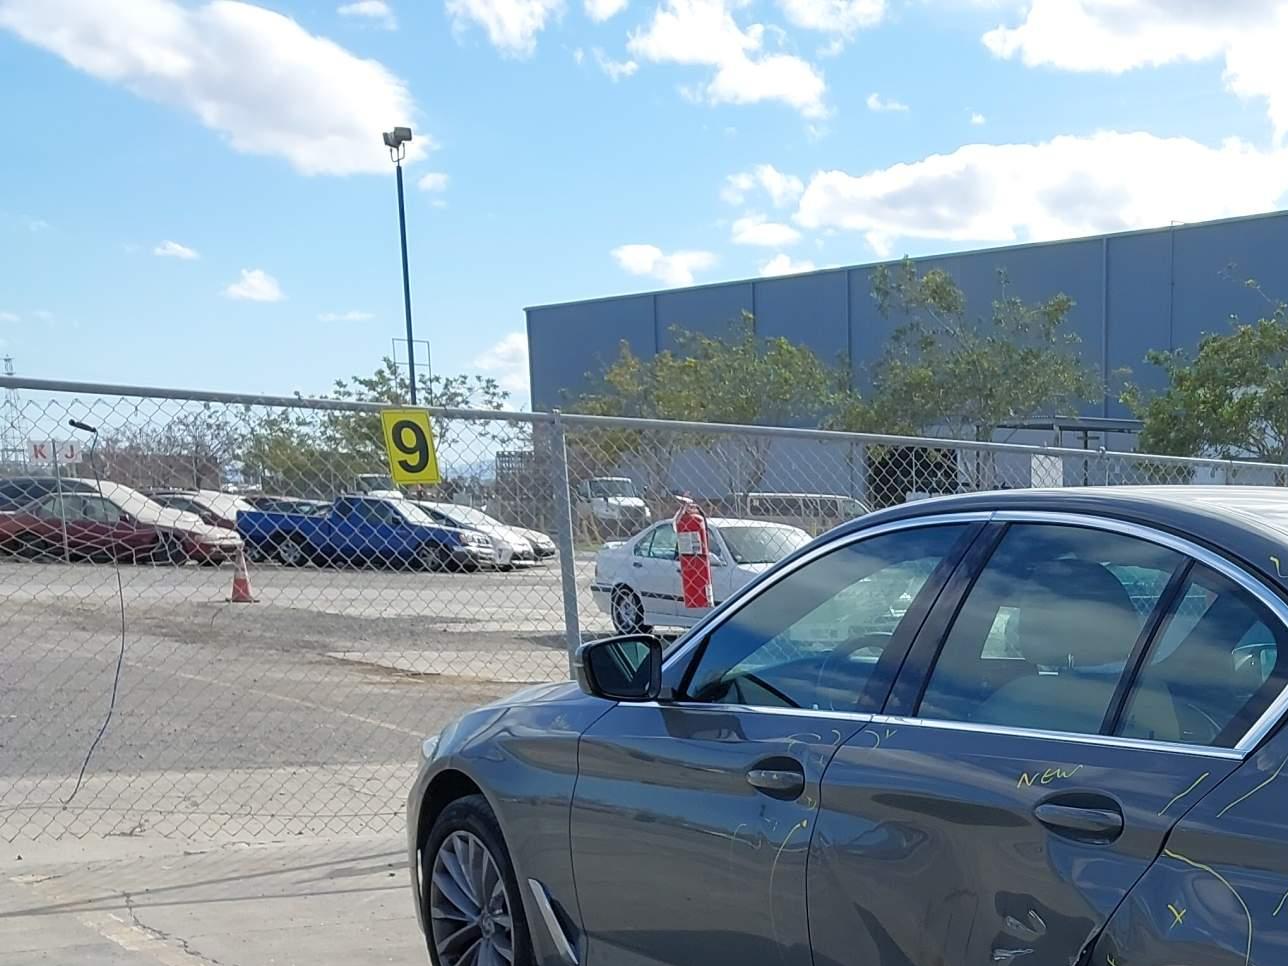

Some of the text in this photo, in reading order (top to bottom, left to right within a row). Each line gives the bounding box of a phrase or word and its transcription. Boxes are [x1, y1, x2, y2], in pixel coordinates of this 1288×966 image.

[33, 444, 46, 459] K
[65, 445, 74, 459] J
[392, 420, 429, 474] 9
